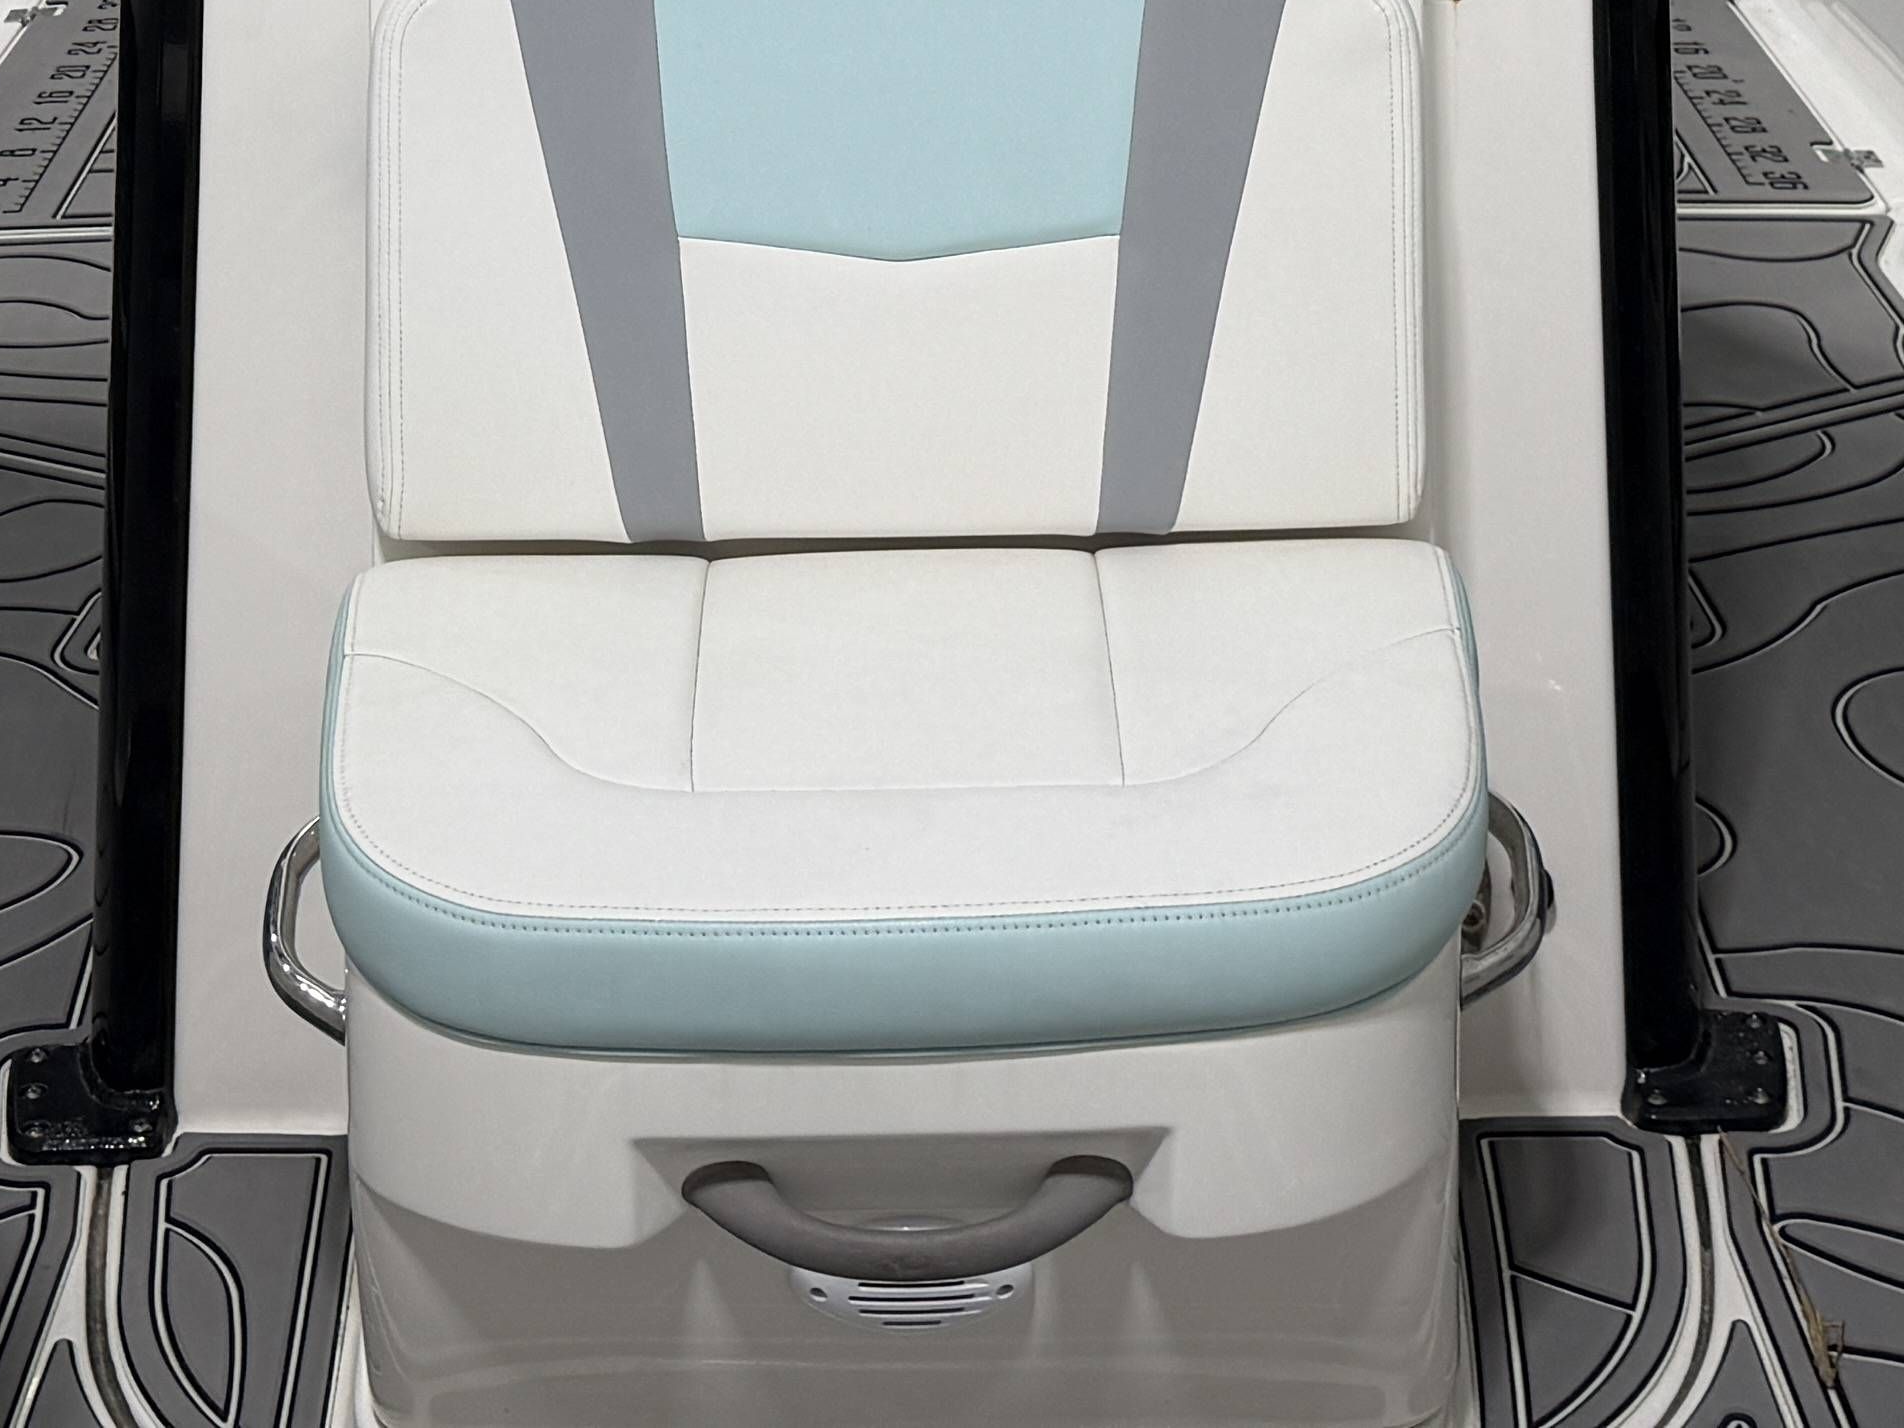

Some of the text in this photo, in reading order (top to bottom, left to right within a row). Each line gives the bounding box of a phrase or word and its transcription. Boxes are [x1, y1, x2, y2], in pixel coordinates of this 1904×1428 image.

[67, 40, 108, 55] 24
[1673, 41, 1710, 55] 16
[49, 64, 91, 80] 20
[33, 90, 75, 105] 16
[14, 116, 59, 133] 12
[1723, 116, 1769, 133] 28
[1744, 145, 1790, 163] 32
[1762, 171, 1810, 190] 36
